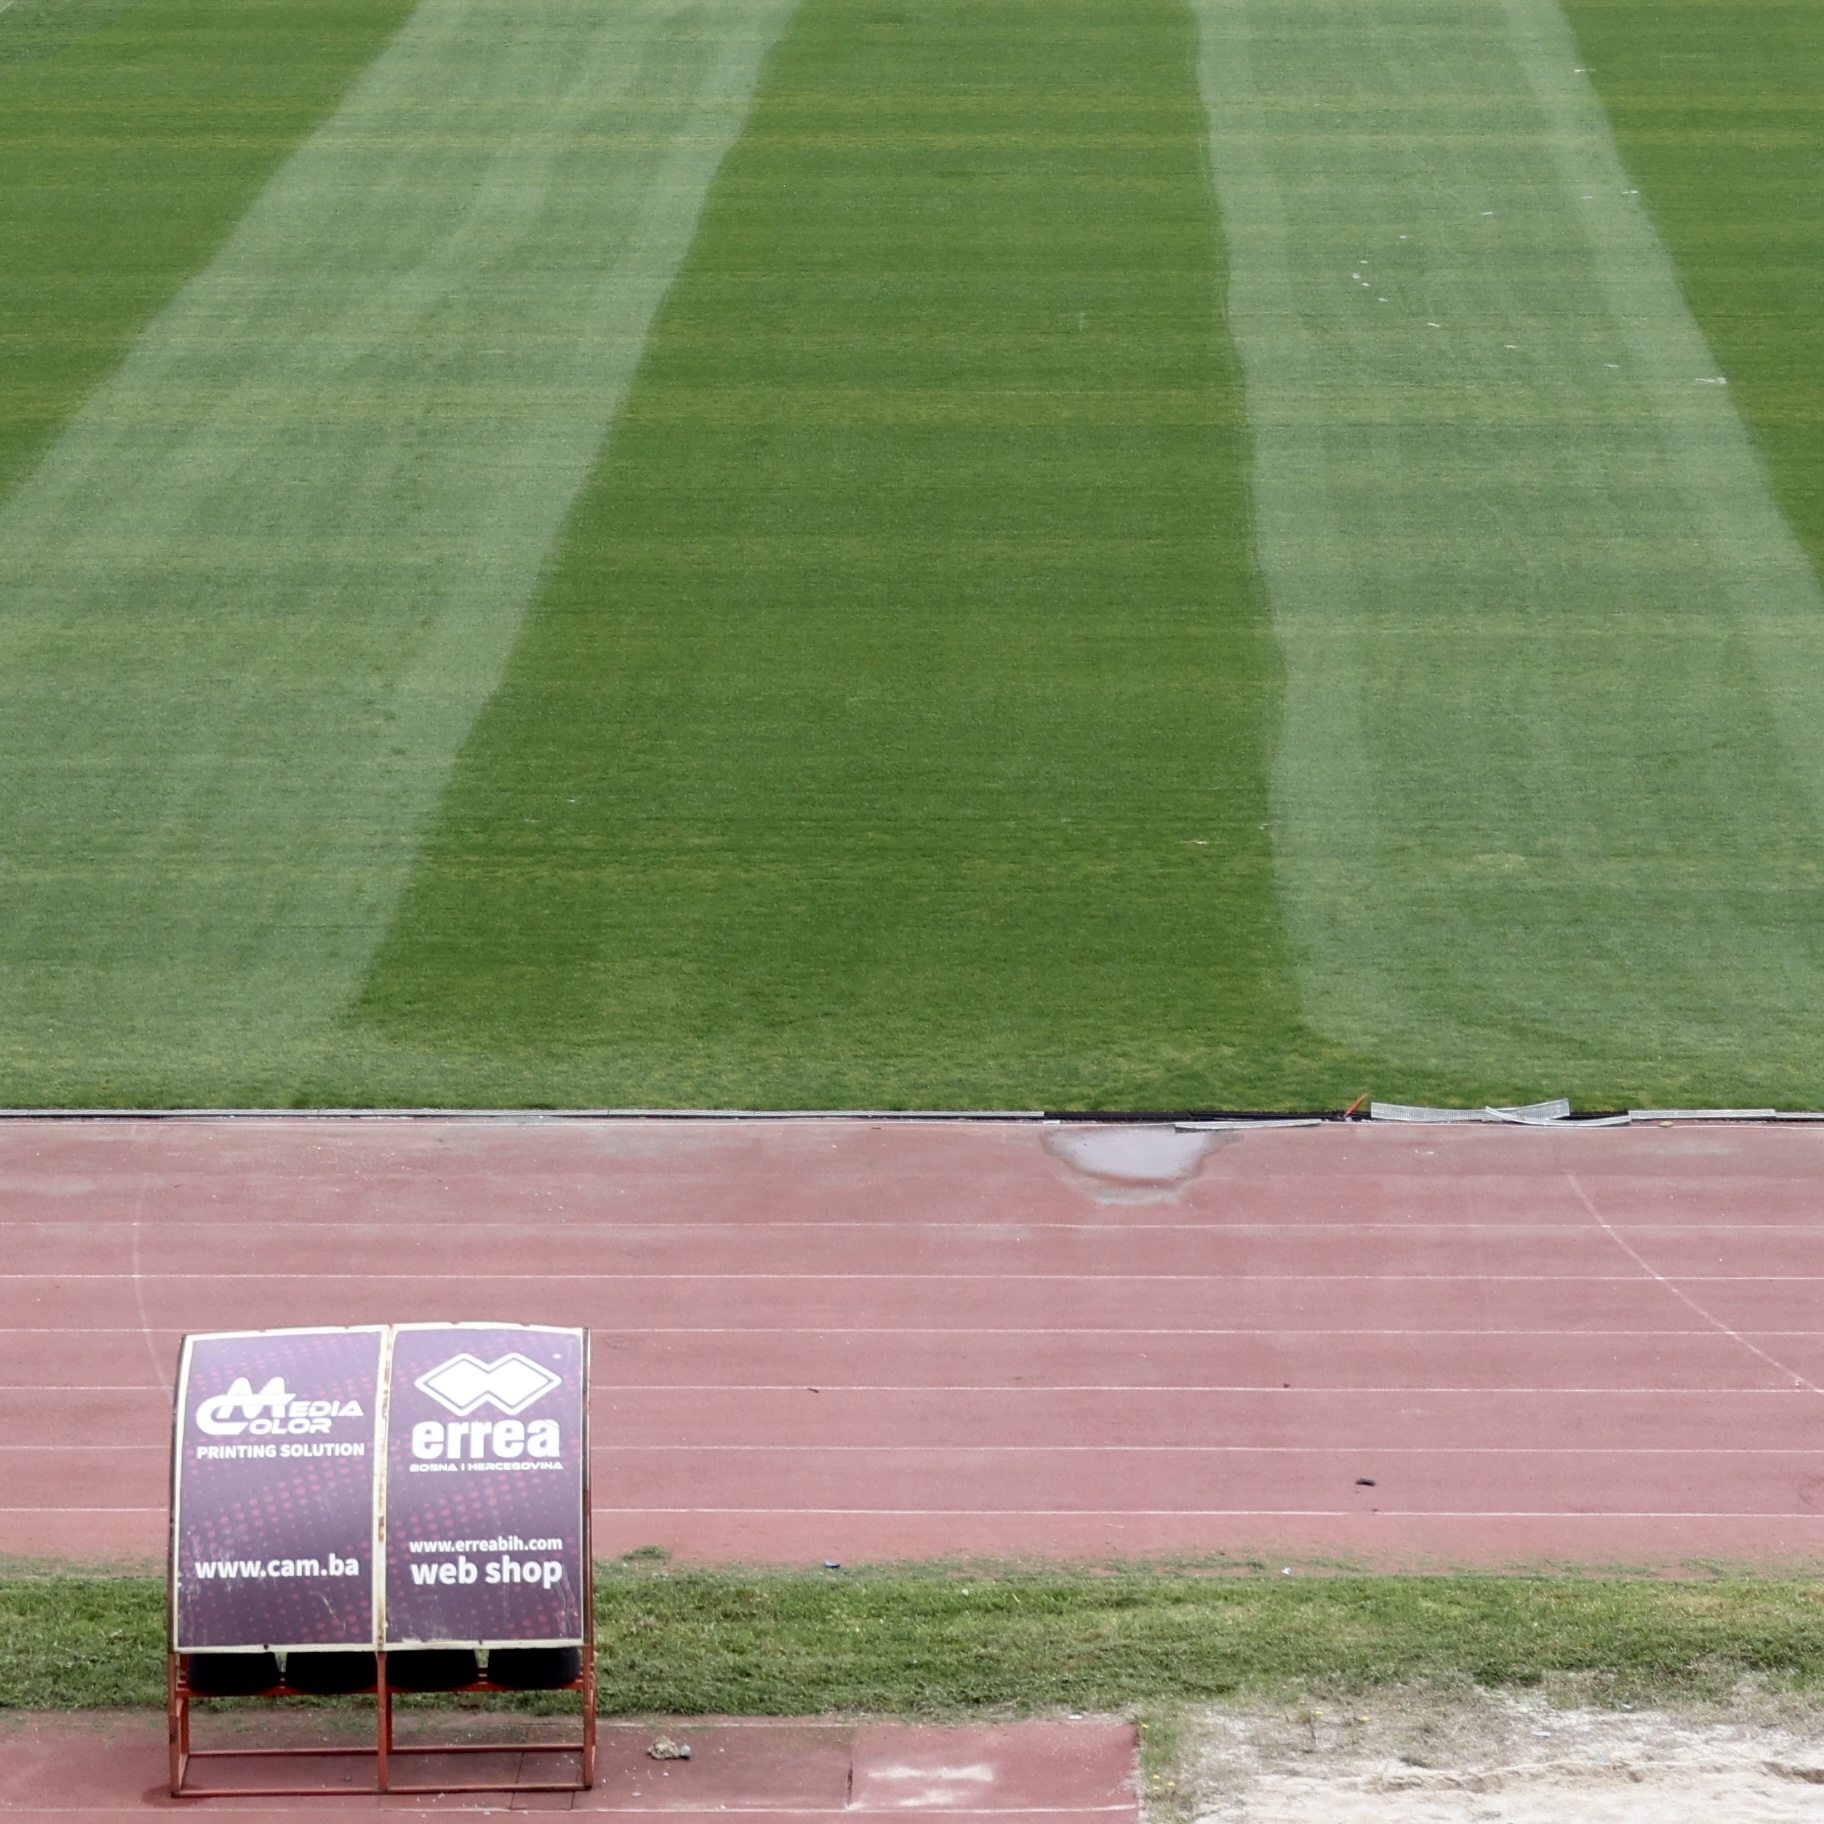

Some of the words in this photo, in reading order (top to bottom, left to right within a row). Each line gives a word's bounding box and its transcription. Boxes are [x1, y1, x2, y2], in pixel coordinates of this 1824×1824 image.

[412, 1419, 560, 1460] errea
[197, 1444, 276, 1460] PRINTING
[280, 1442, 365, 1457] SOLUTION
[409, 1463, 458, 1472] BOSNA
[468, 1461, 564, 1471] HERCEGOVINA
[409, 1536, 563, 1553] www.erreabih.com
[195, 1553, 359, 1578] www.cam.ba
[410, 1556, 477, 1585] web
[485, 1555, 563, 1589] shop
